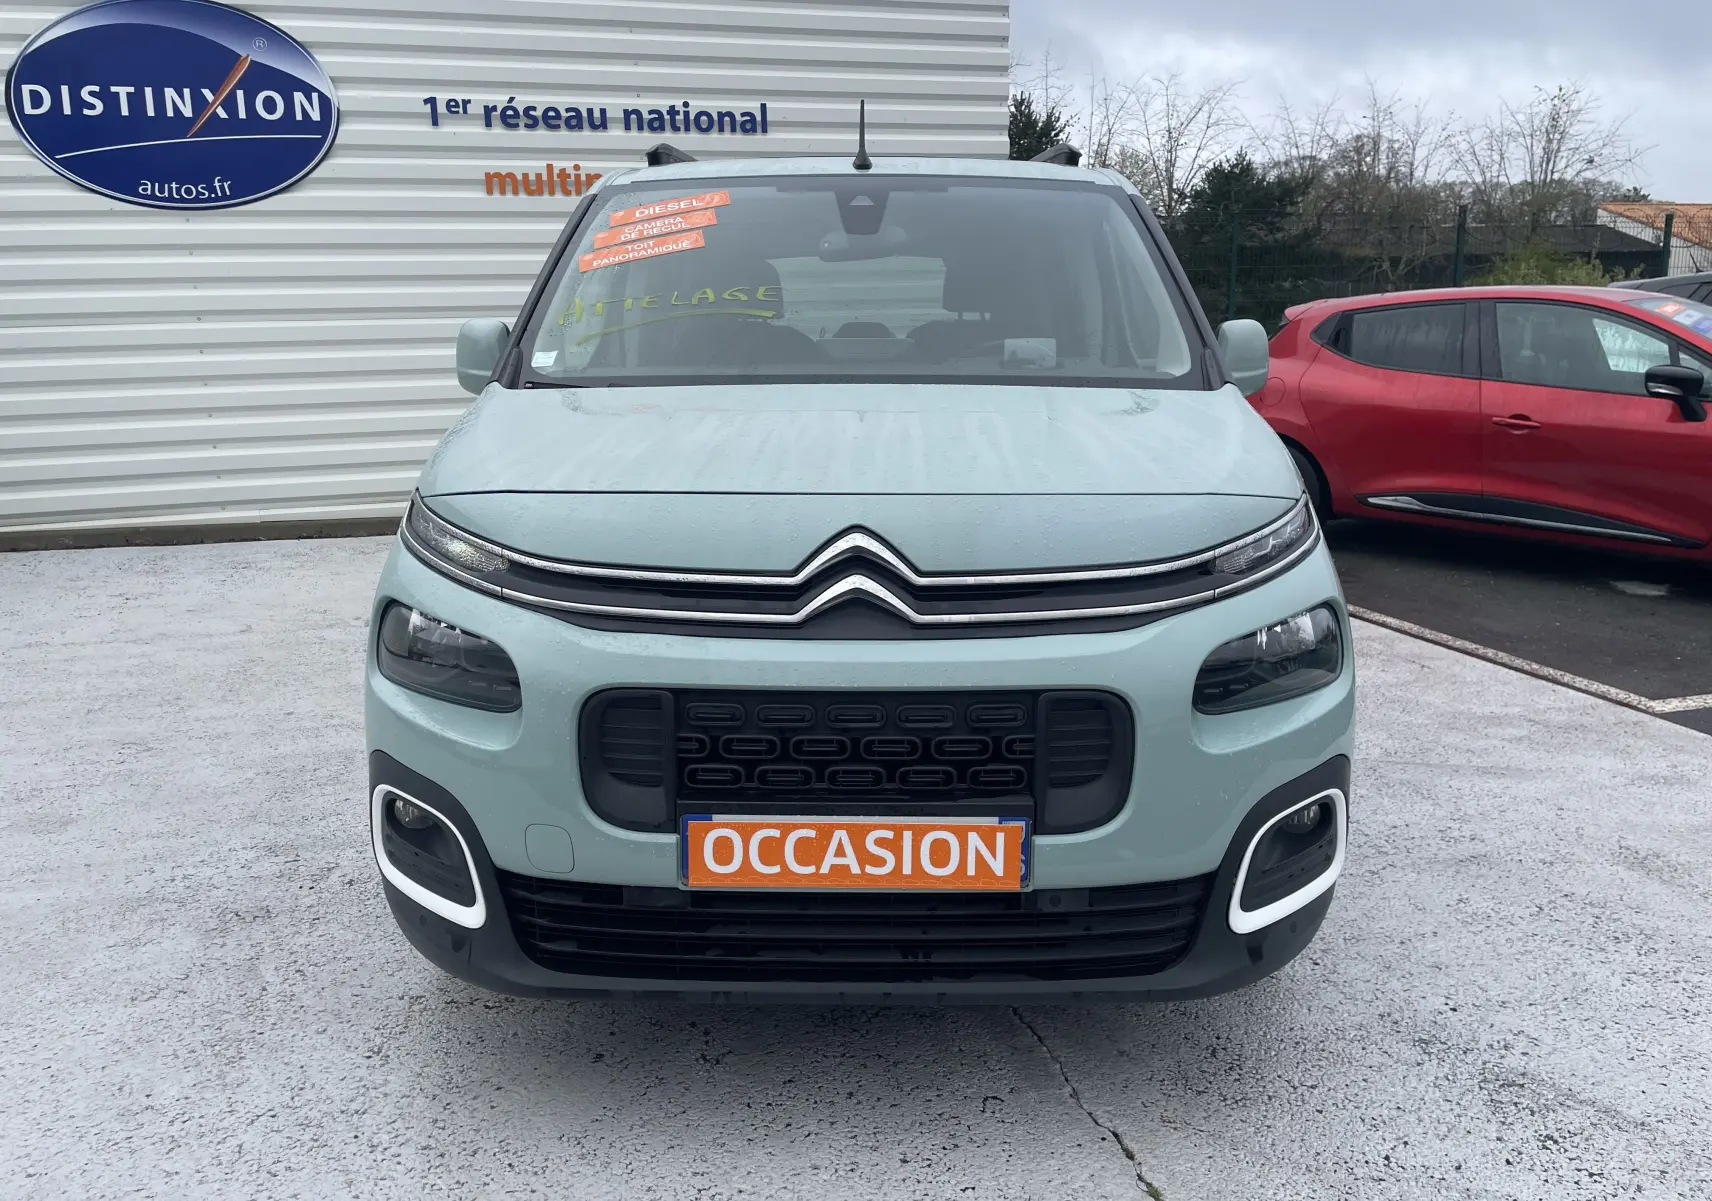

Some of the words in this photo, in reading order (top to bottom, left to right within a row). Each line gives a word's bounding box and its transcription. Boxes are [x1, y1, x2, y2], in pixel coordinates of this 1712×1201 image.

[21, 83, 322, 122] DISTINXION
[483, 97, 608, 131] réseau
[623, 101, 768, 134] national
[138, 177, 232, 199] autos.fr
[635, 198, 705, 218] DIESEL
[621, 231, 639, 241] DE
[643, 223, 691, 236] RECUL
[592, 240, 692, 267] PANORAMIQUE
[626, 240, 656, 252] TOIT
[557, 285, 783, 326] ATTELAGE
[703, 828, 1005, 877] OCCASION
